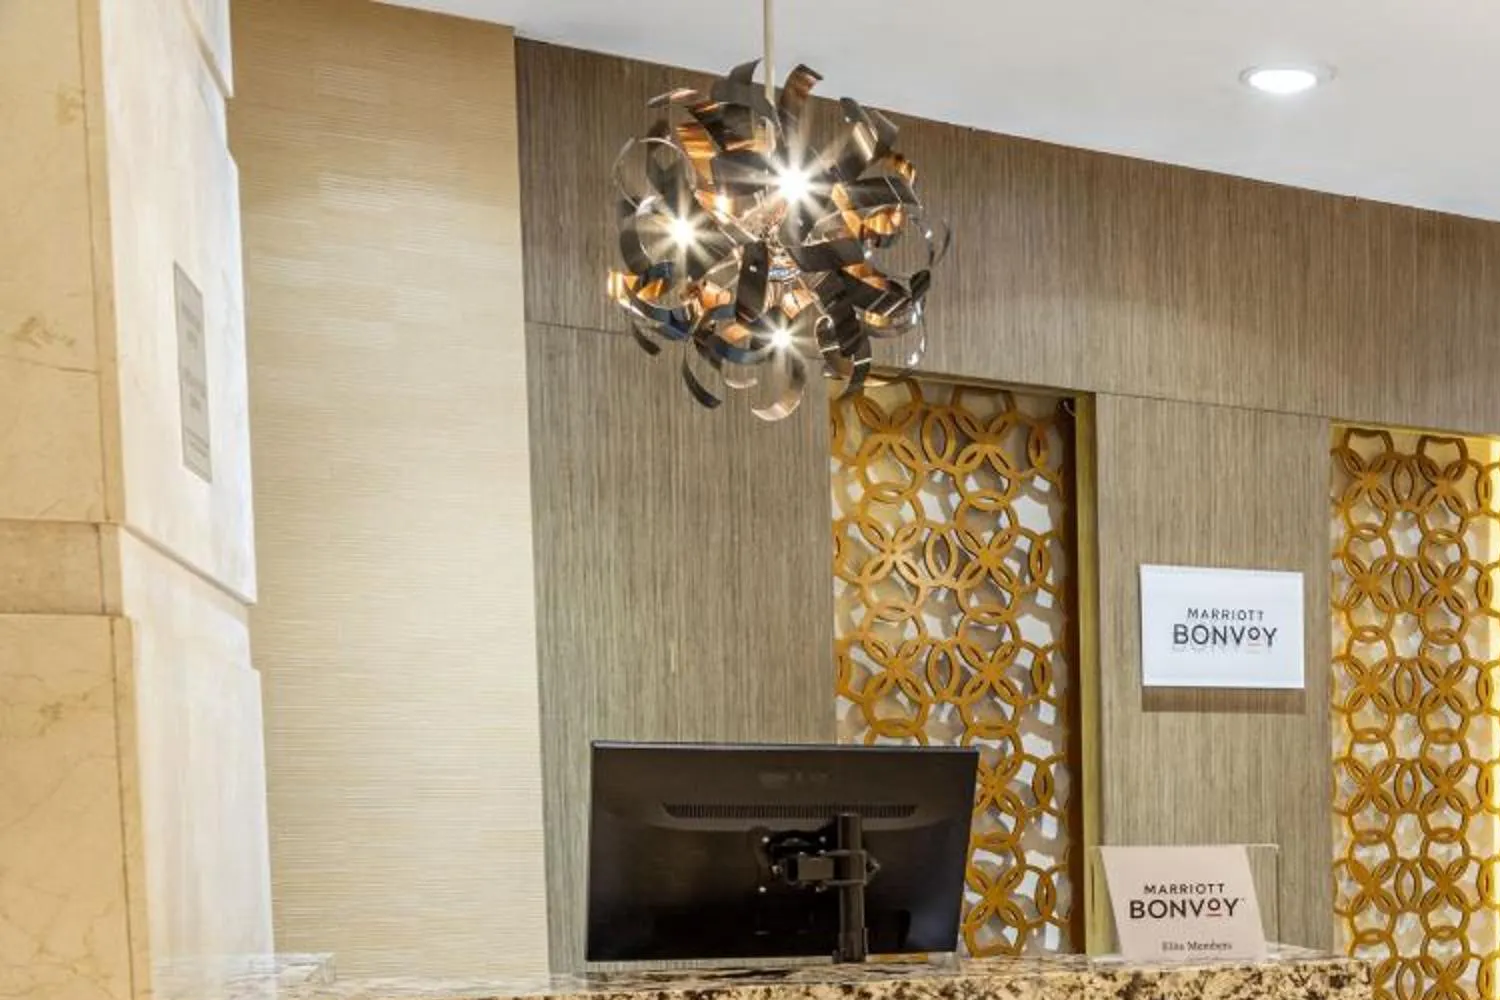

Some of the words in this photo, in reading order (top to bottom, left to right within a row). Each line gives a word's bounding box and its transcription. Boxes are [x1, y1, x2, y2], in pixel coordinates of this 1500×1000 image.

[1187, 607, 1264, 621] MARRIOTT
[1173, 624, 1277, 647] BONVOY
[1144, 883, 1225, 895] MARRIOTT
[1129, 898, 1239, 919] BONVOY
